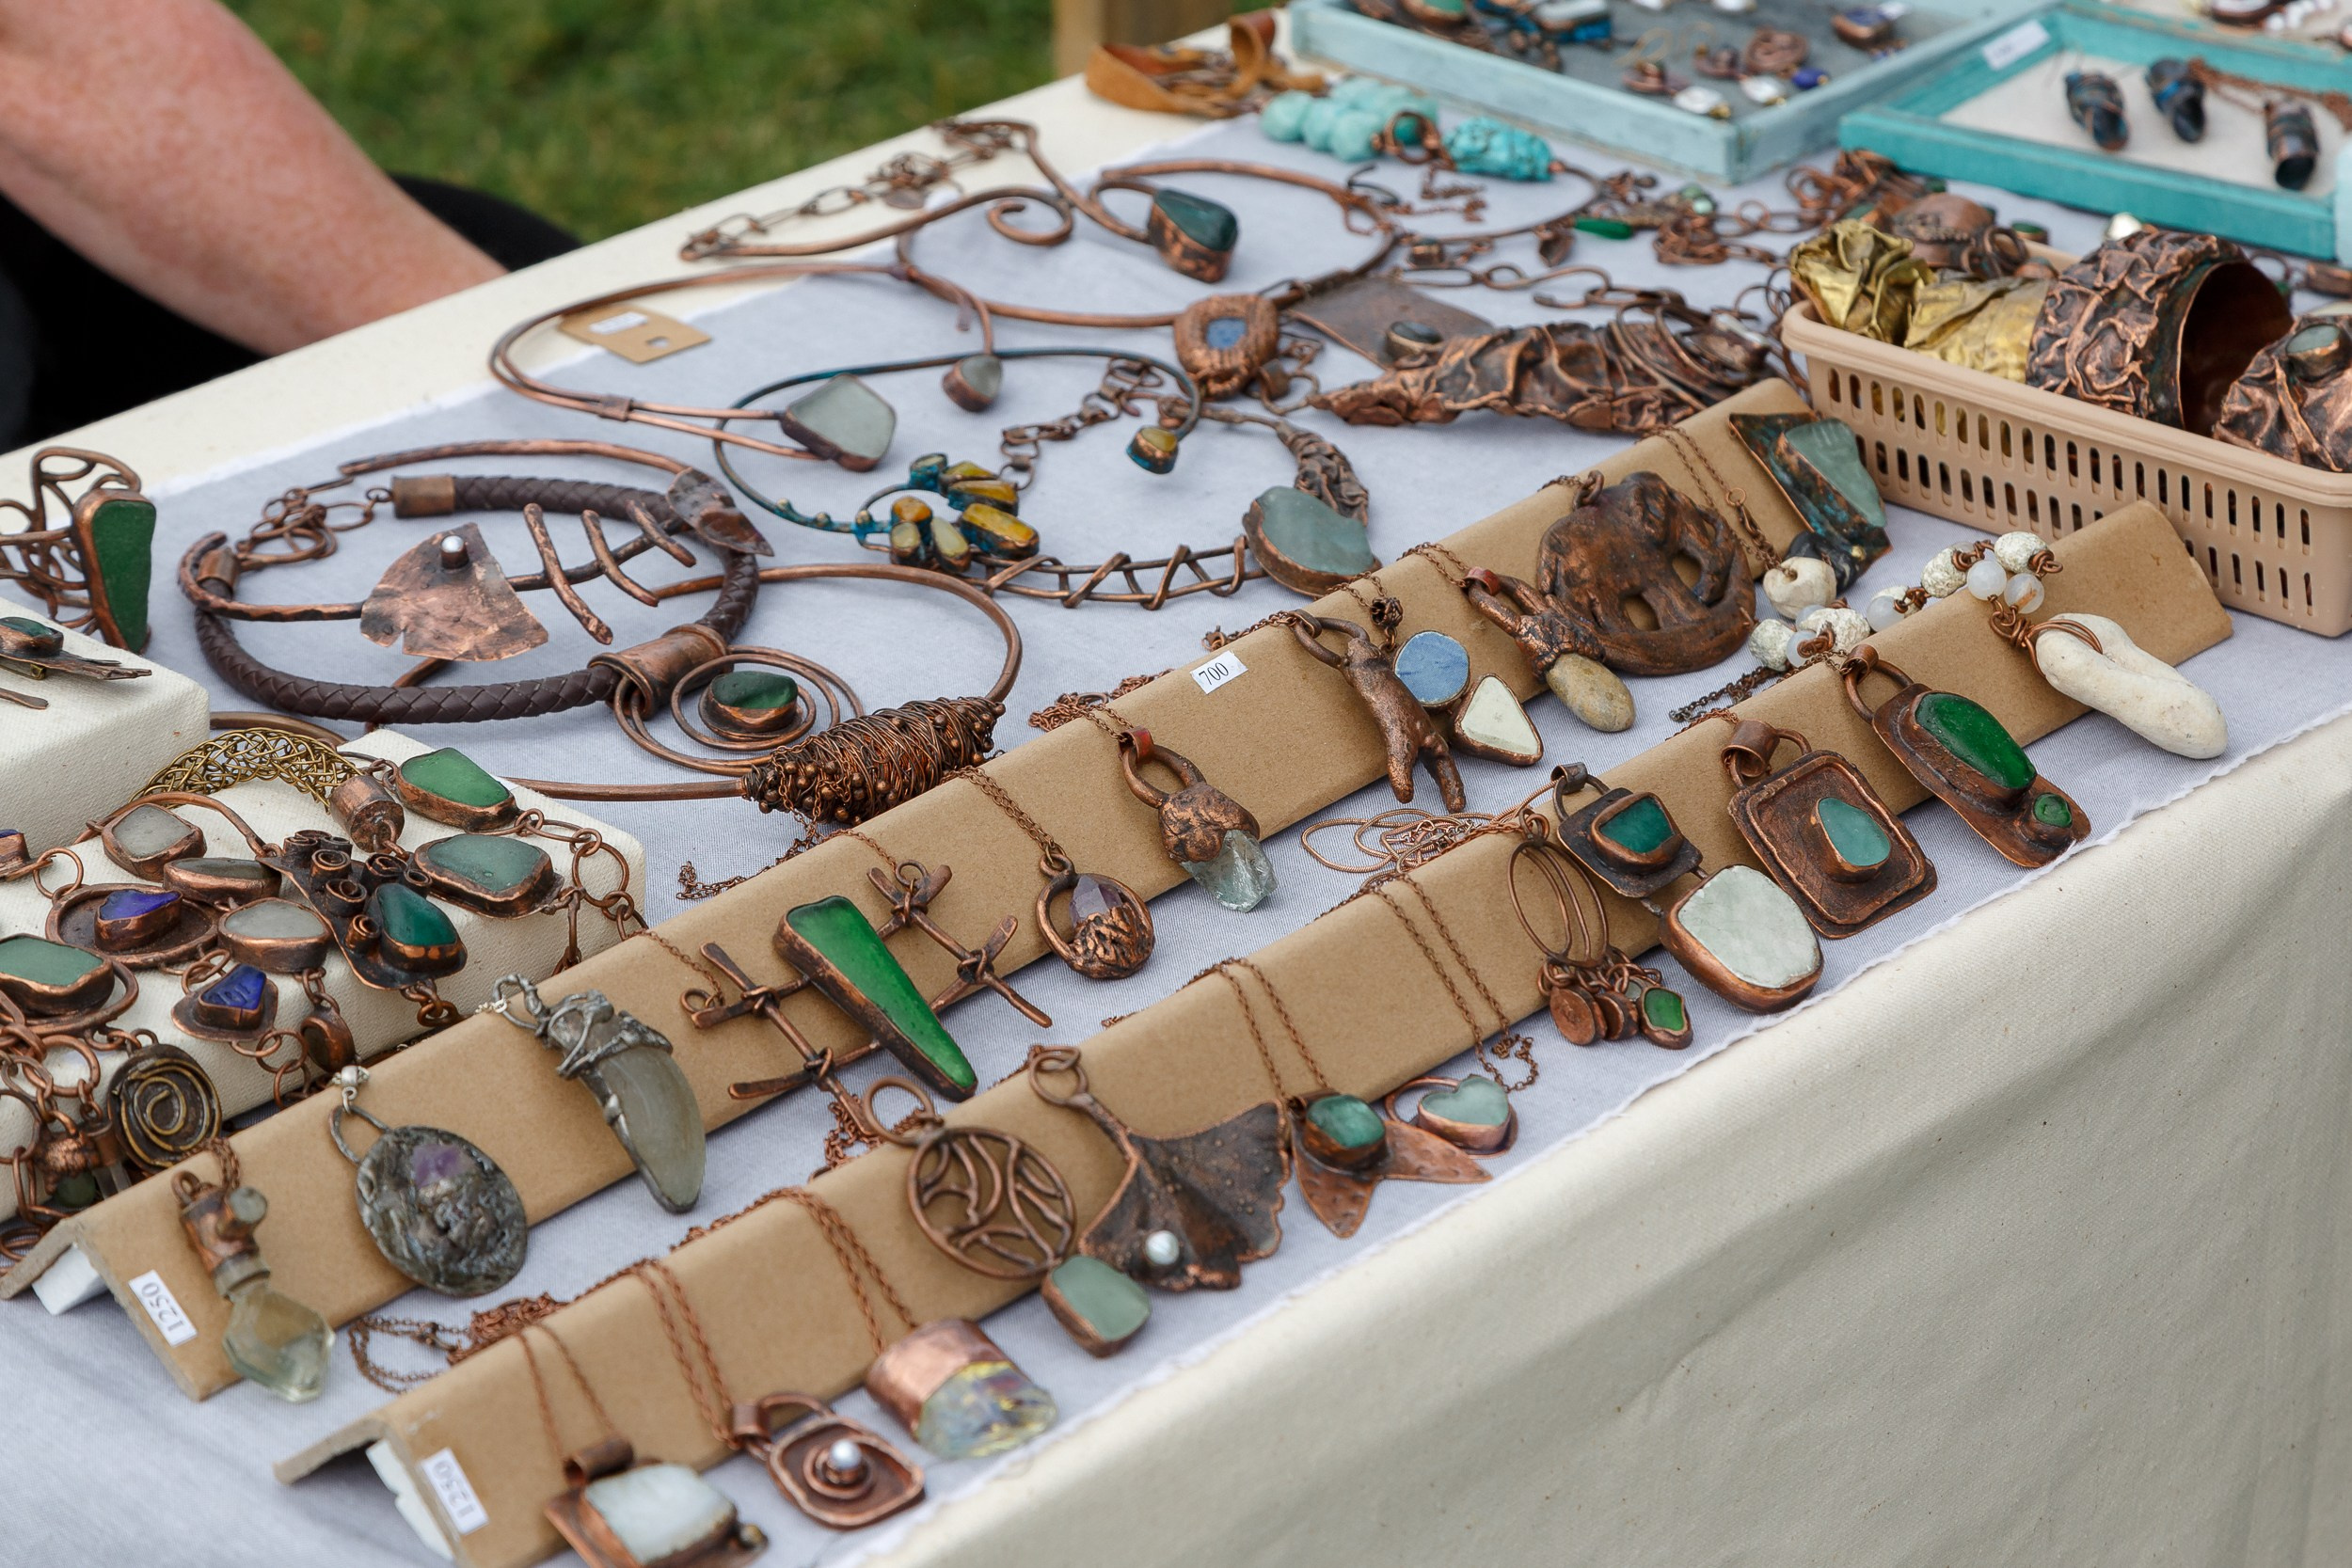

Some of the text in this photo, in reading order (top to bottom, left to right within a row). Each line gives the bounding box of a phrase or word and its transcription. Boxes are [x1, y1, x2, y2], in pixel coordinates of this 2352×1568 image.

[1199, 662, 1230, 686] 700
[141, 1282, 184, 1332] 1250
[433, 1460, 474, 1518] 1250
